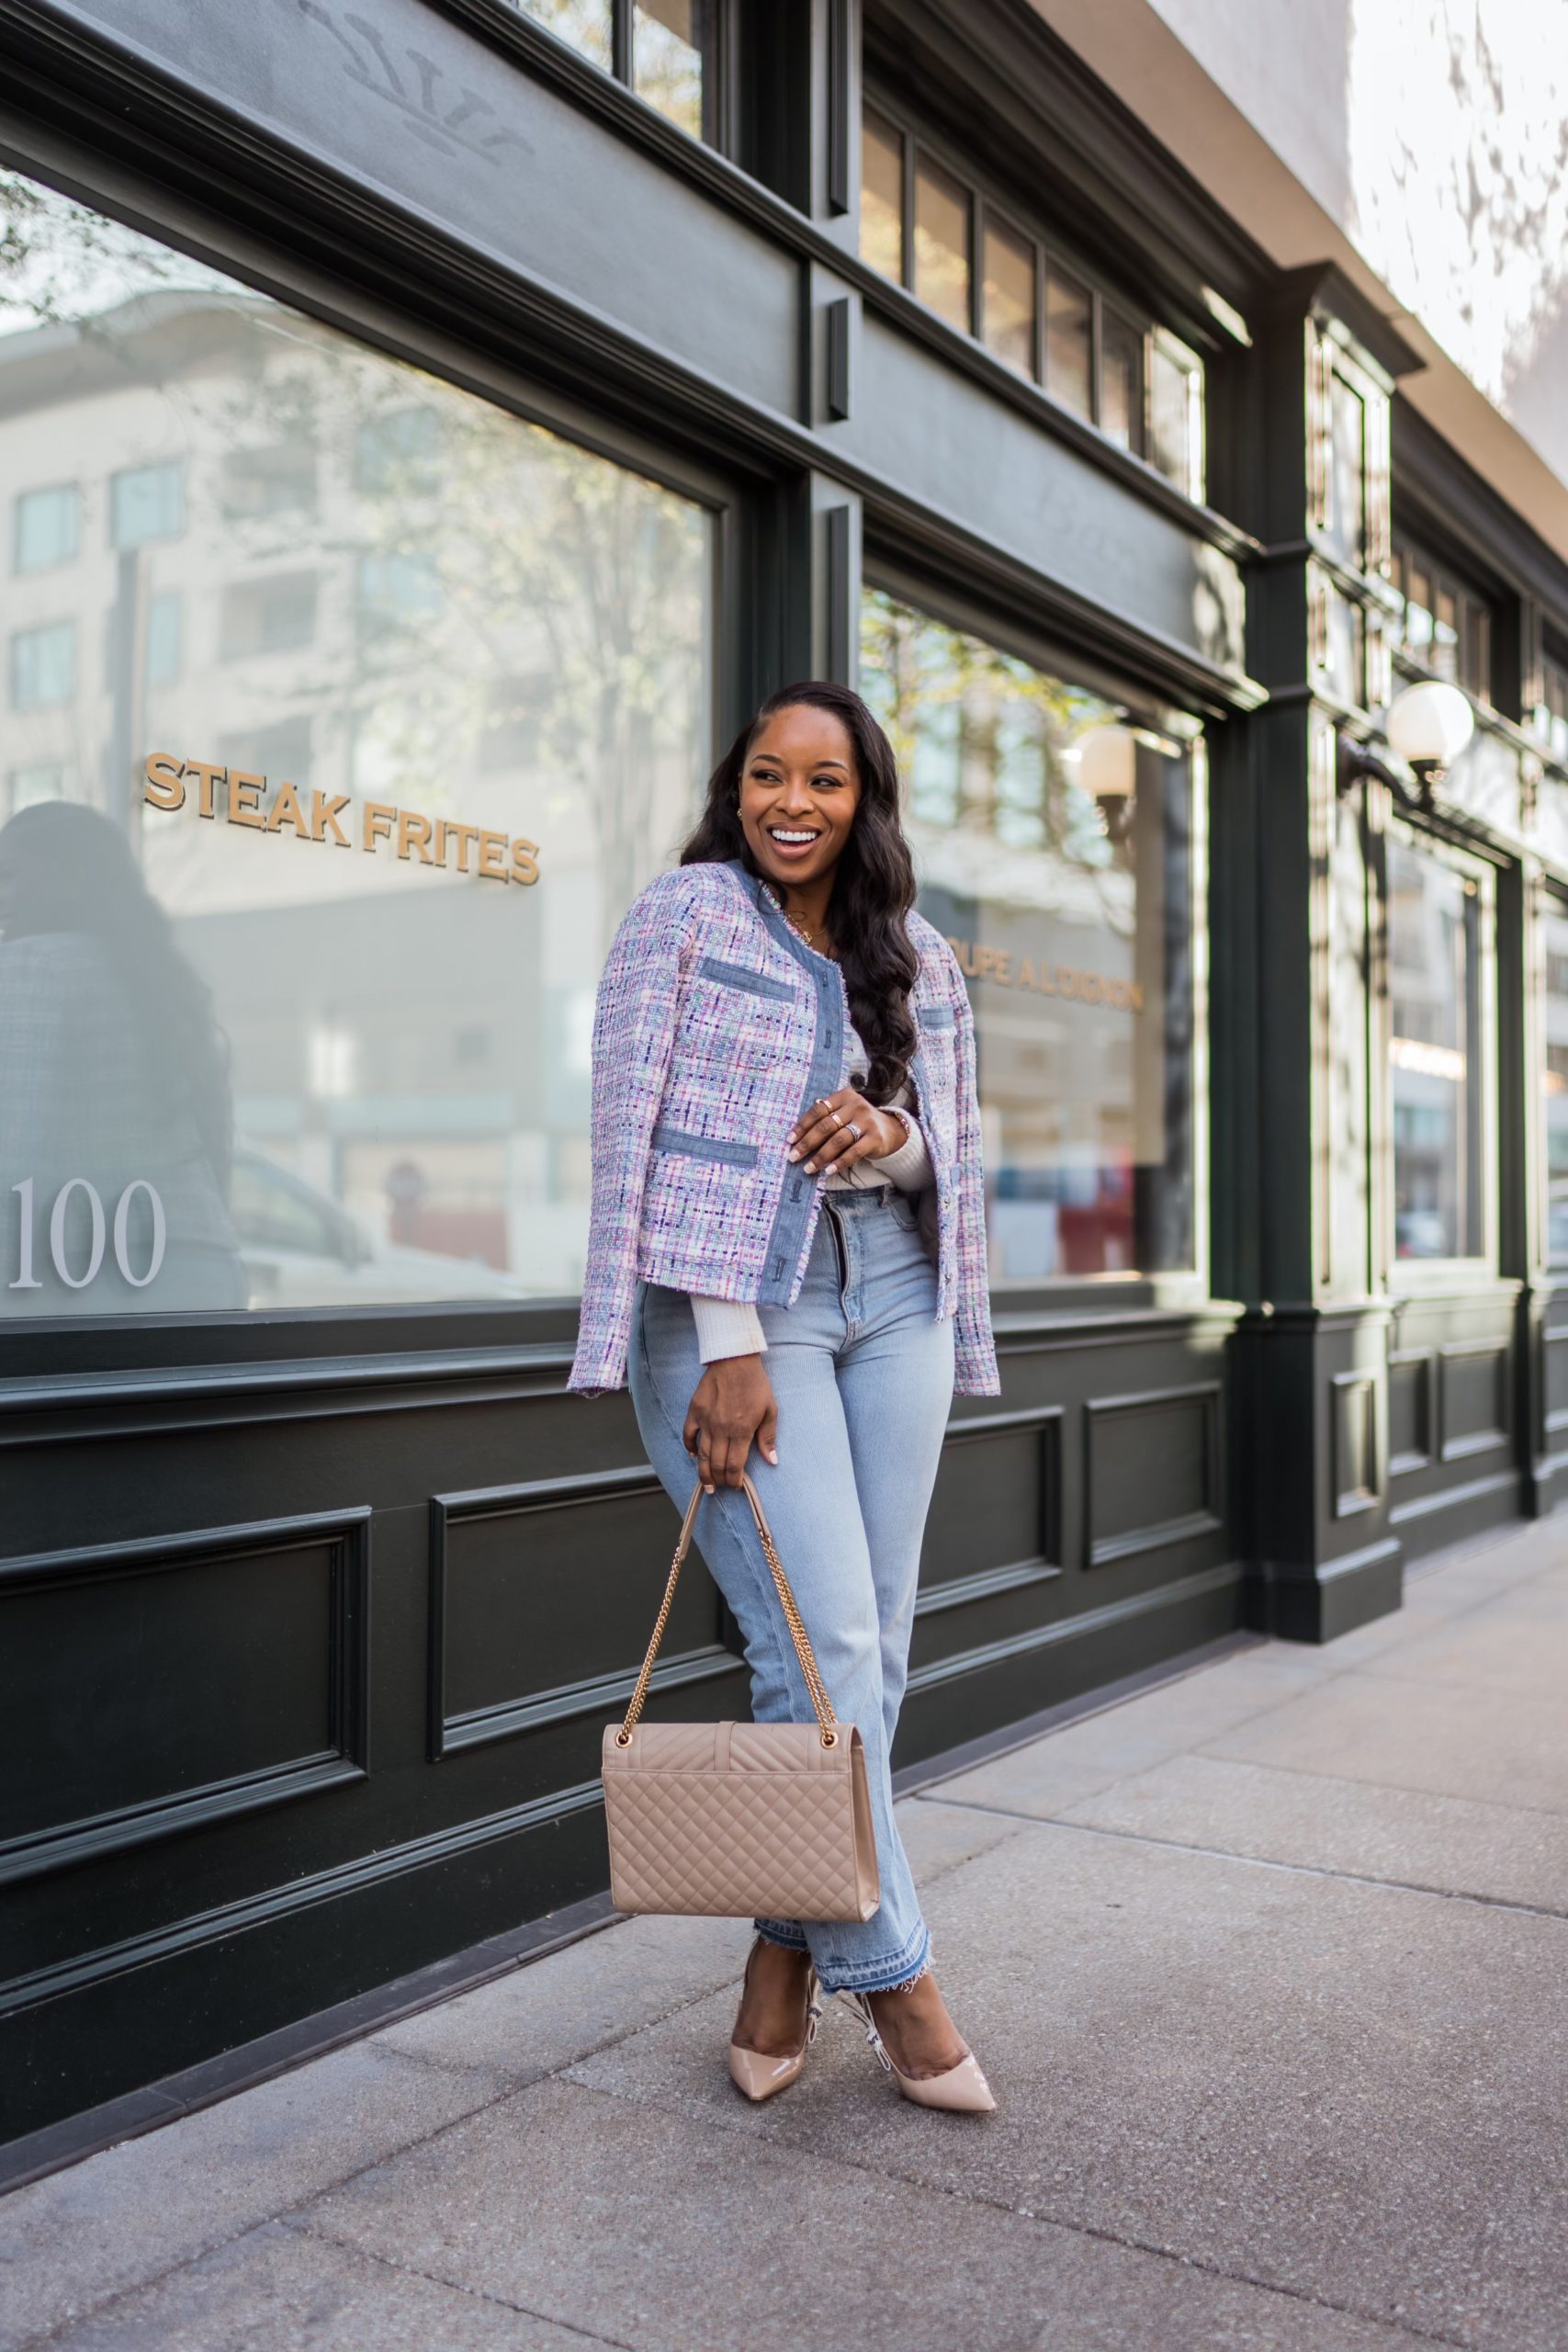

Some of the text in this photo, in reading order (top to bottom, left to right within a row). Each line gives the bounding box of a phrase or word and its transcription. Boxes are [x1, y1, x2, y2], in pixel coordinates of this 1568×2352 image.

[144, 752, 540, 887] STEAK FRITES
[945, 935, 1014, 986] OUPE
[7, 1176, 166, 1288] 100
